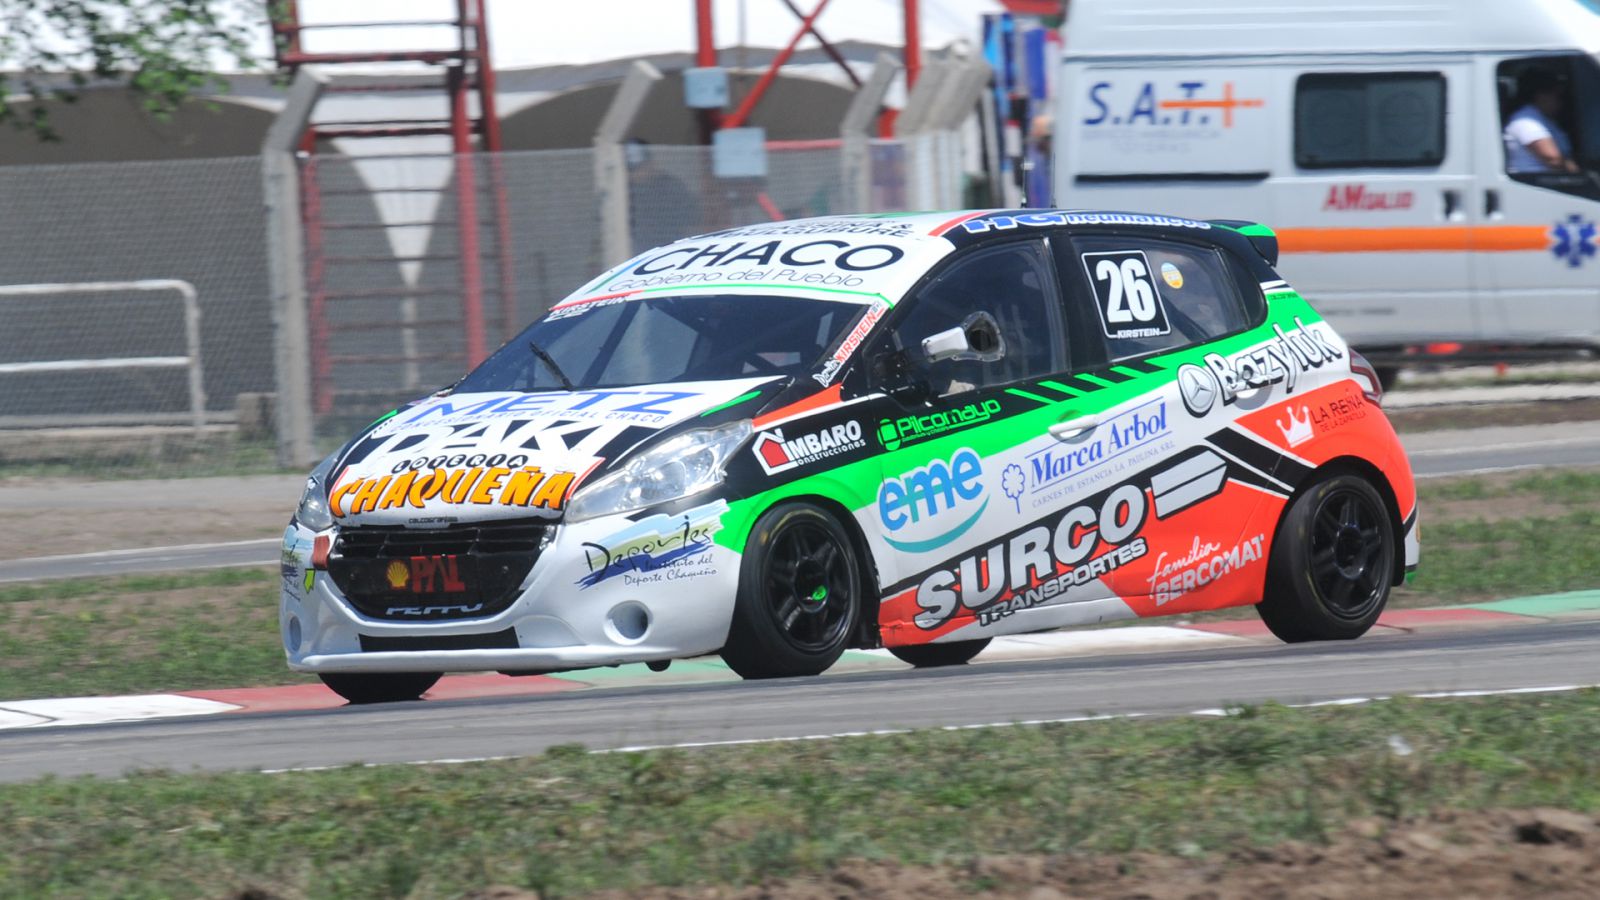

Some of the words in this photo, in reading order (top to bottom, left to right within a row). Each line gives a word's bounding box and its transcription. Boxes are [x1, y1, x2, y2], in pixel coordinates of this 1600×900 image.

[962, 213, 1067, 233] HG
[633, 239, 905, 276] CHACO
[608, 271, 722, 292] Gobierno
[727, 268, 773, 282] del
[773, 268, 864, 287] Pueblo
[1095, 258, 1156, 323] 26
[834, 311, 879, 364] KIRSTEIN
[1117, 328, 1160, 339] KIRSTEIN
[401, 391, 700, 424] METZ
[530, 410, 599, 419] OFICIAL
[604, 412, 665, 423] CHACO
[897, 399, 1001, 437] Pilcomayo
[1310, 406, 1329, 425] LA
[1031, 439, 1103, 488] Marca
[1108, 402, 1168, 455] Arbol
[330, 465, 577, 519] CHAQUEÑA
[878, 449, 985, 532] eme
[1032, 490, 1063, 508] CARNES
[1064, 485, 1075, 496] DE
[1076, 469, 1112, 489] ESTANCIA
[697, 553, 714, 566] del
[913, 484, 1145, 631] SURCO
[1156, 534, 1264, 607] BERCOMAT
[624, 574, 663, 587] Deporte
[666, 568, 718, 582] Chaqueño
[976, 536, 1148, 627] TRANSPORTES
